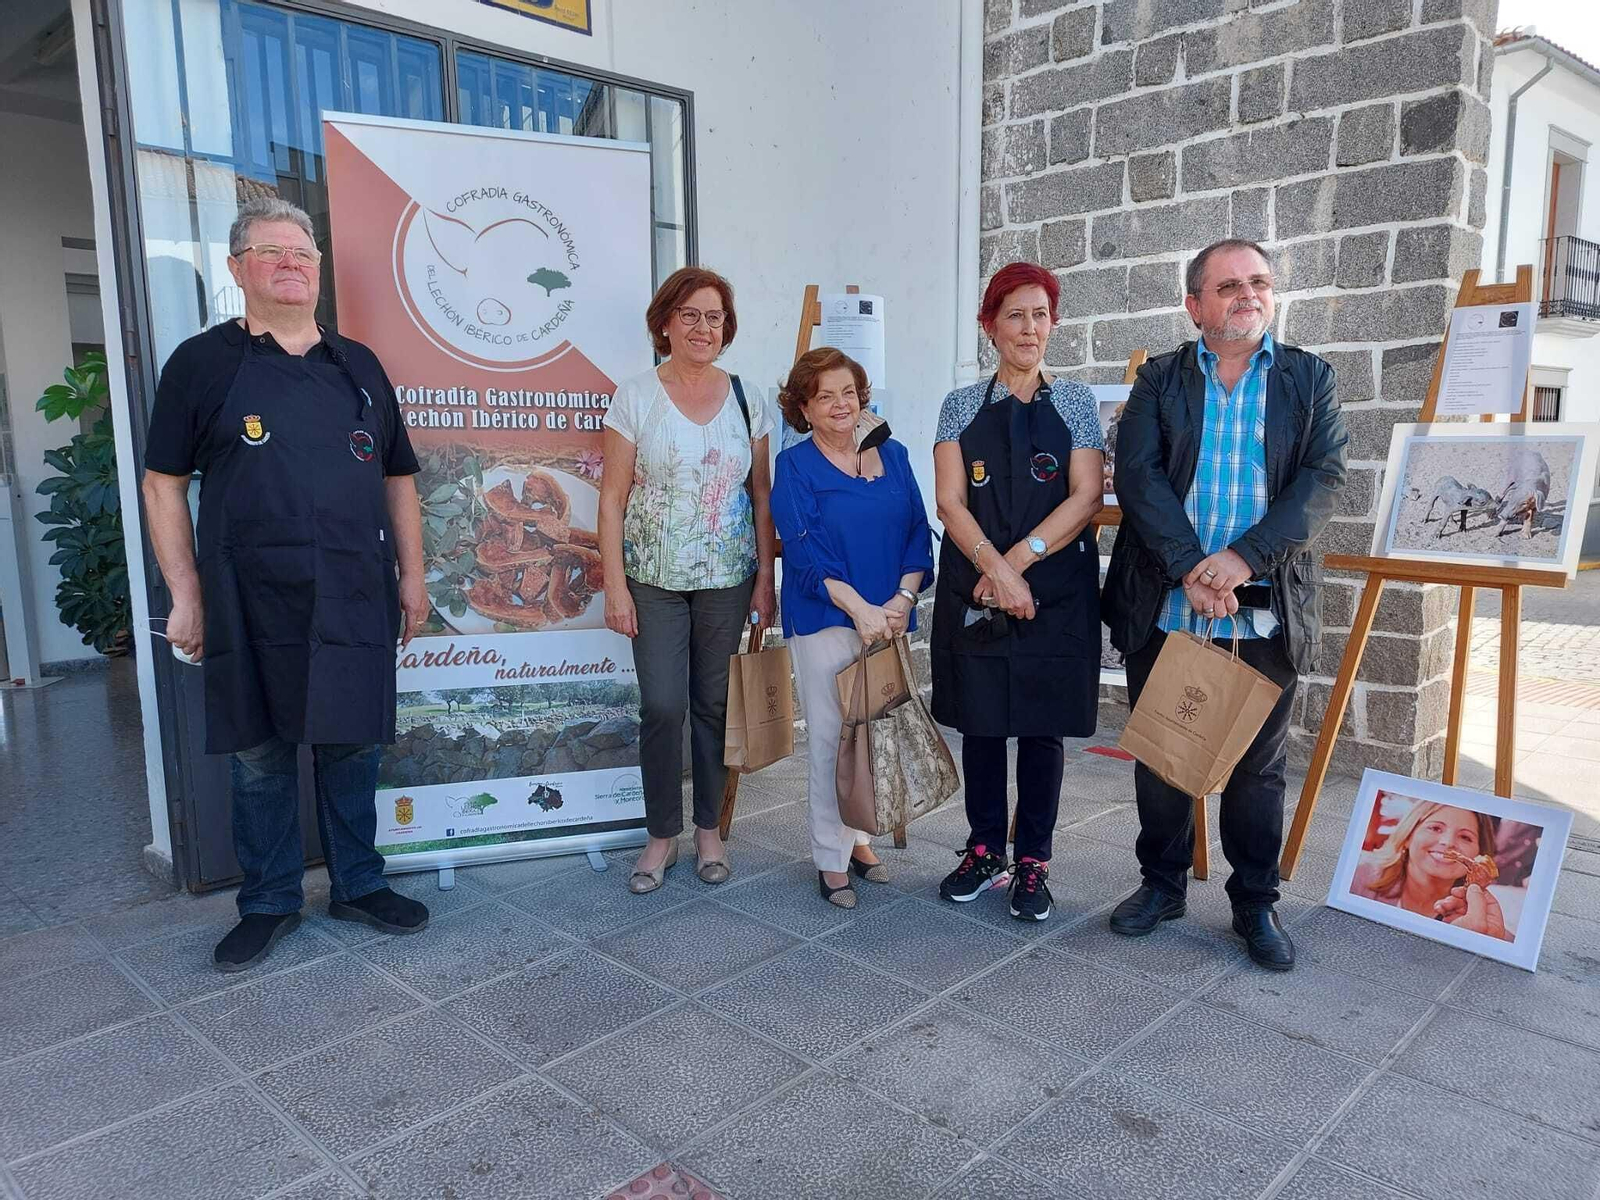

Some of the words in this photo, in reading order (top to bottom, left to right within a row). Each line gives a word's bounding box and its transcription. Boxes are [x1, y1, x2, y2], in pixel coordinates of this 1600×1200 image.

[512, 191, 580, 271] GASTRONÓMICA
[427, 264, 436, 280] DEL
[427, 280, 464, 327] LECHÓN
[531, 299, 575, 341] CARDEÑA
[516, 333, 529, 343] DE
[395, 385, 478, 406] Cofradía
[485, 387, 611, 410] Gastronómica
[399, 407, 465, 428] echón
[471, 408, 539, 429] Ibérico
[545, 411, 567, 430] de
[574, 411, 607, 431] Car
[494, 656, 618, 680] naturalmente
